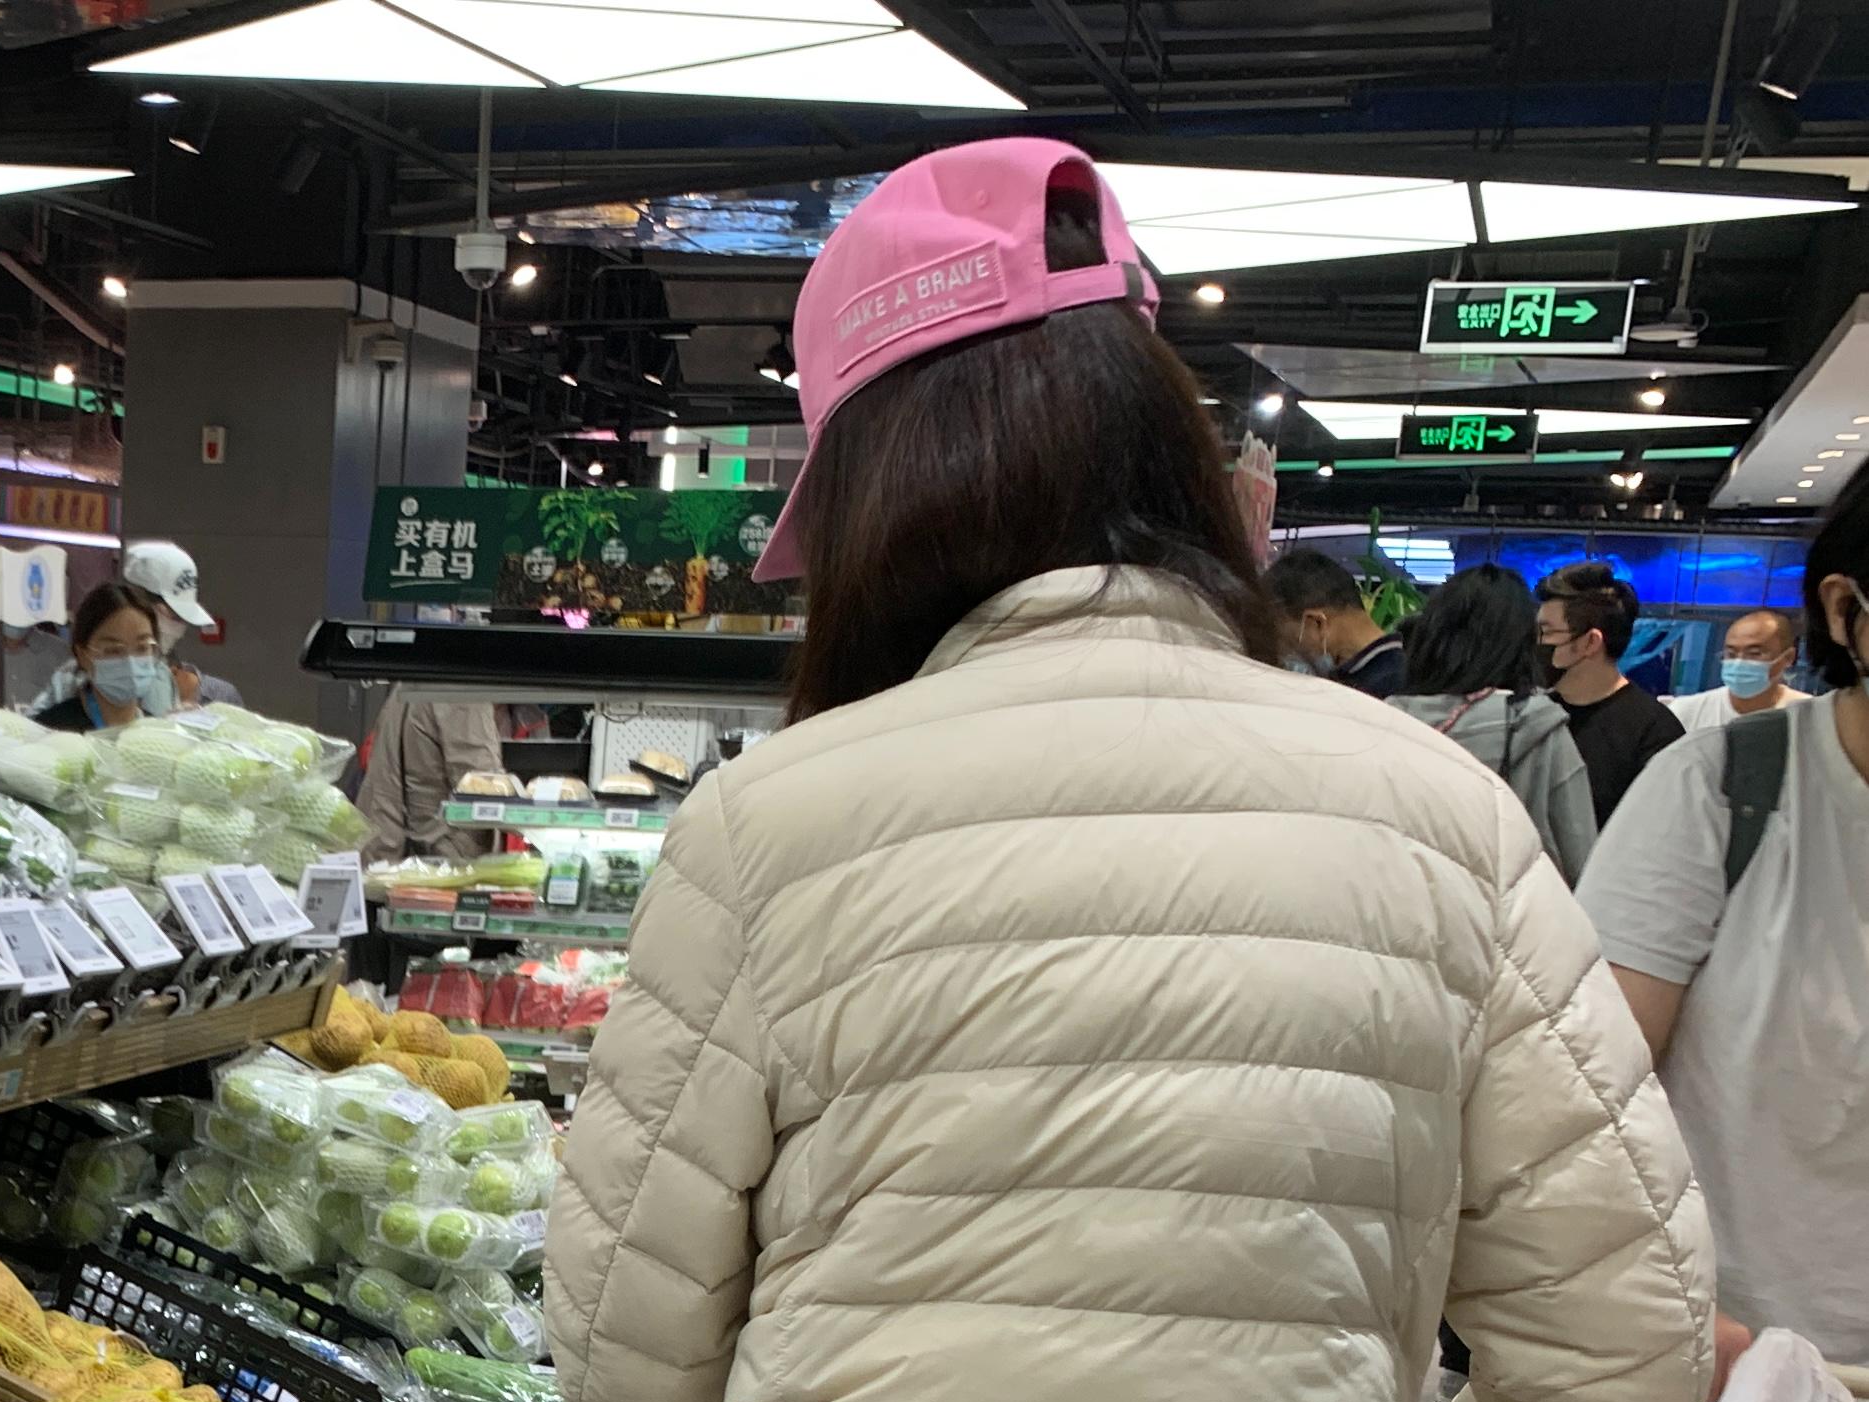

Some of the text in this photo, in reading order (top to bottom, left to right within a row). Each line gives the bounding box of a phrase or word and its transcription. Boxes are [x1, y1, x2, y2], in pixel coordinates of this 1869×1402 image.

[837, 254, 990, 341] MAKE A BRAVE
[1457, 303, 1501, 319] 安全出口
[1459, 319, 1496, 329] EXIT
[1421, 437, 1446, 446] EXIT
[394, 519, 479, 549] 买有机
[389, 550, 475, 580] 上盒马
